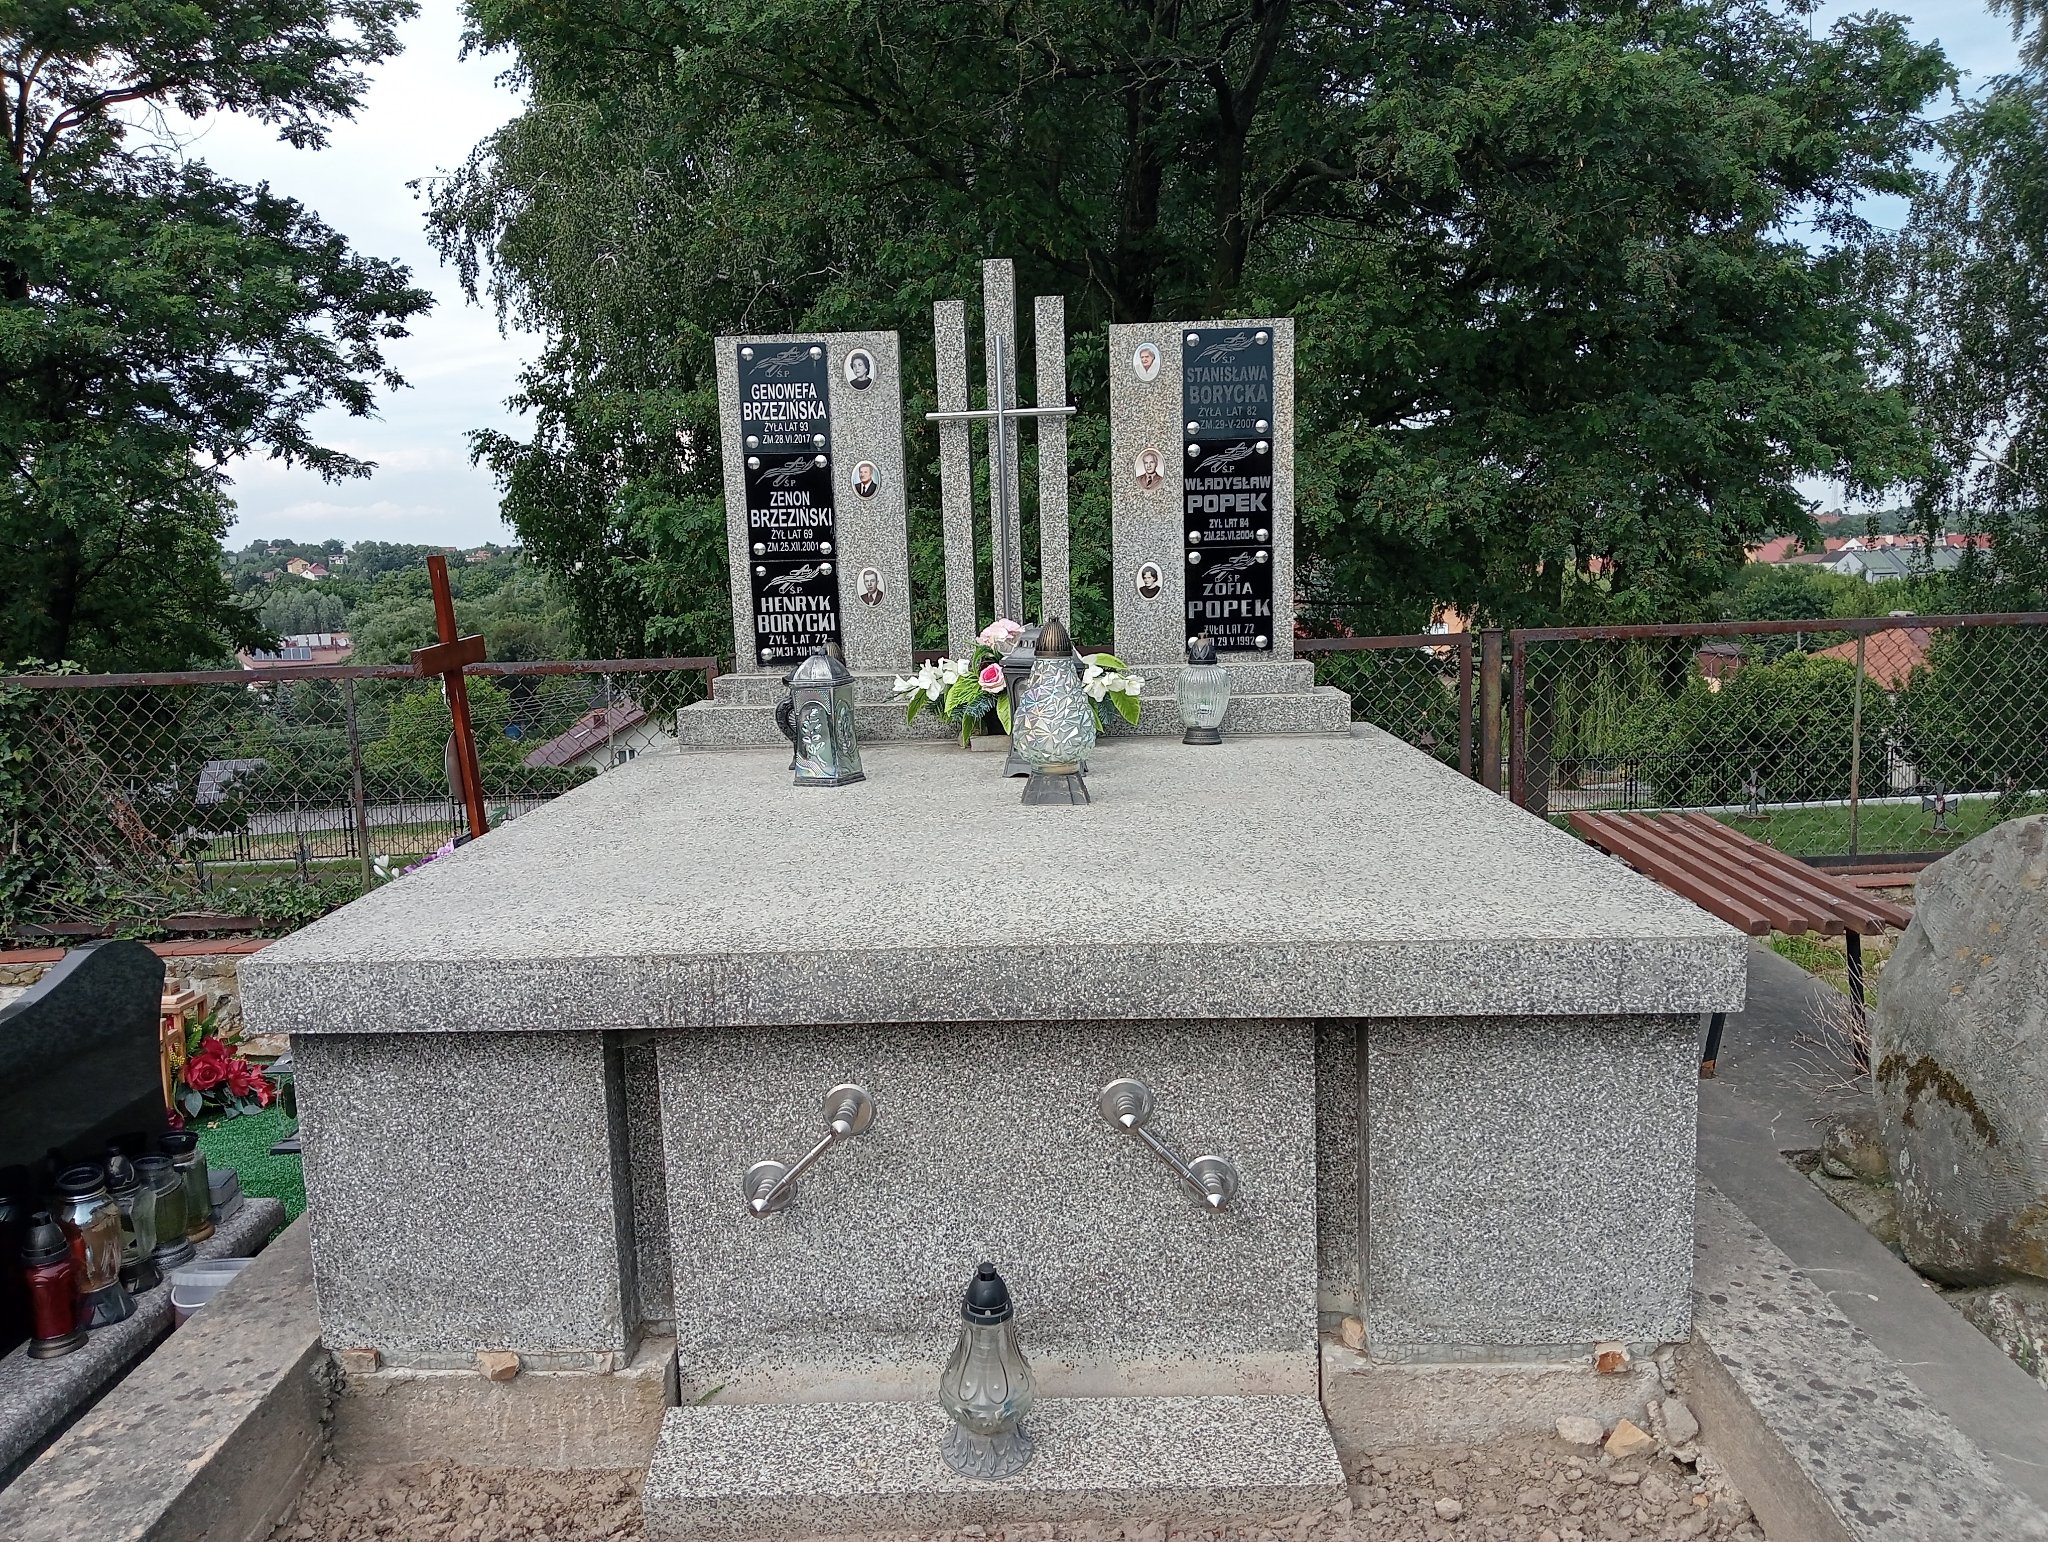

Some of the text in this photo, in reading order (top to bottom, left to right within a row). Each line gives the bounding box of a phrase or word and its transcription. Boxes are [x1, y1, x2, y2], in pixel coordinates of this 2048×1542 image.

[1187, 365, 1268, 382] STANISŁAWA
[751, 383, 817, 400] GENOWEFA
[1189, 384, 1268, 404] BORYCKA
[743, 399, 826, 420] BRZEZIŃSKA
[1198, 406, 1257, 416] ŻYŁA LAT 82
[764, 421, 808, 432] ŻYŁA LAT 93
[1185, 476, 1271, 490] WŁADYSŁAW
[770, 491, 810, 506] ZENON
[1188, 493, 1267, 513] POPEK
[751, 506, 832, 528] BRZEZIŃSKI
[1225, 518, 1237, 528] LAT
[771, 528, 813, 539] ŻYŁ LAT 69
[1202, 582, 1253, 595] ZOFIA
[761, 596, 830, 612] HENRYK
[1188, 599, 1270, 618] POPEK
[758, 613, 836, 633] BORYCKI
[1226, 624, 1241, 634] LAT
[1245, 624, 1254, 634] 72
[792, 634, 810, 644] LAT
[815, 634, 828, 644] 72
